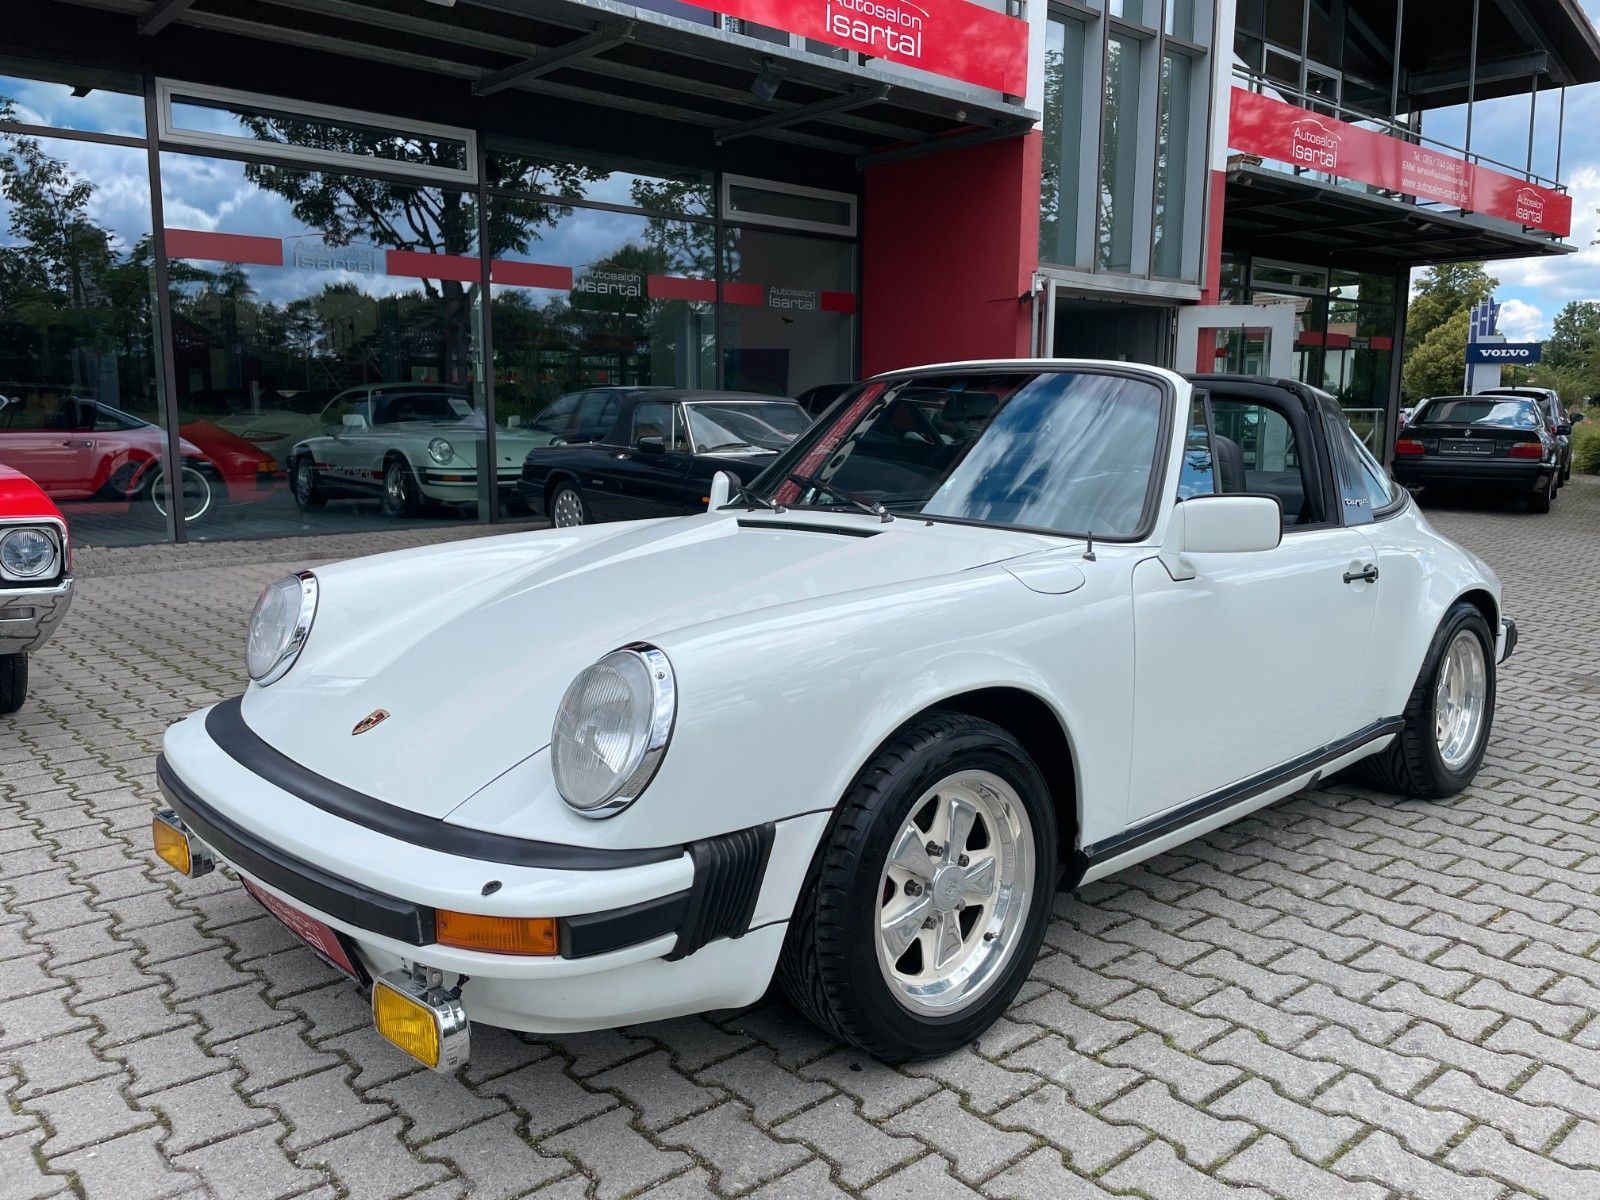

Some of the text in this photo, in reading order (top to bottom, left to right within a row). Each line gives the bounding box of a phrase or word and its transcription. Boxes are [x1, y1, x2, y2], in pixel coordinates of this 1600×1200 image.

[826, 0, 922, 30] utosalon
[826, 3, 921, 58] Isartal
[1294, 127, 1337, 149] Autosalon
[1292, 138, 1337, 168] Isartal
[1516, 201, 1542, 223] Isartal
[1518, 194, 1543, 209] Autosalon
[293, 251, 376, 274] Isartal
[585, 266, 641, 282] Autosalon
[581, 277, 641, 297] Isartal
[769, 286, 816, 298] Autosalon
[769, 294, 816, 310] Isartal
[1479, 349, 1530, 357] VOLVO
